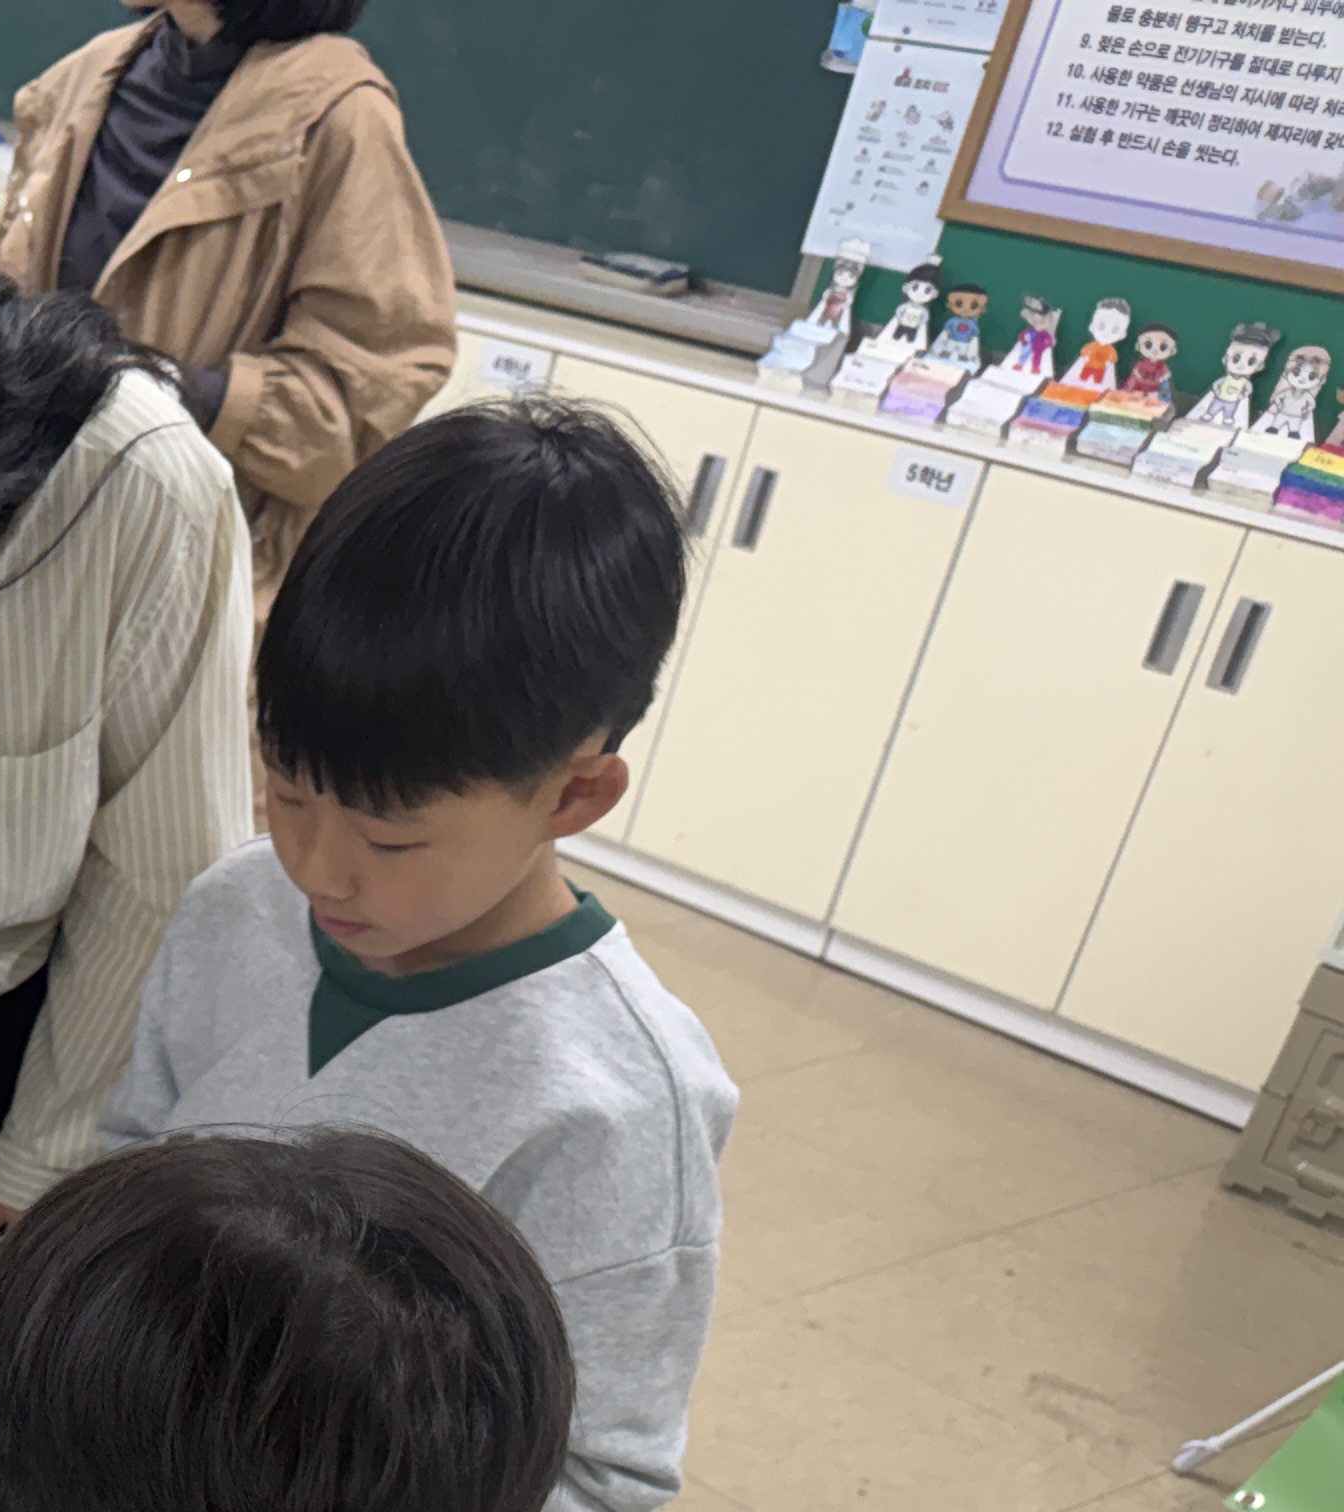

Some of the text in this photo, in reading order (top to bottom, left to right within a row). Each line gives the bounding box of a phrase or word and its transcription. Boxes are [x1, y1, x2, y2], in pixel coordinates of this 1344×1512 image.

[1107, 5, 1136, 23] 물로
[1138, 8, 1183, 31] 충분히
[1231, 20, 1278, 43] 처치를
[1278, 26, 1327, 49] 받는다.
[1079, 33, 1344, 85] 9. 젖은 손으로 전기기구를 절대로 다루지
[1067, 63, 1085, 79] 10.
[1090, 65, 1133, 87] 사용한
[1136, 71, 1179, 93] 약품은
[1180, 78, 1239, 103] 선생님의
[1240, 87, 1288, 109] 지시에
[1288, 94, 1321, 114] 따라
[1046, 121, 1241, 167] 12. 실험 후 반드시 손을 씻는다.
[1056, 92, 1075, 109] 11.
[1079, 96, 1120, 117] 사용한
[1121, 101, 1161, 123] 기구는
[1163, 107, 1206, 130] 깨끗이
[1207, 114, 1264, 138] 정리하여
[1264, 123, 1323, 148] 제자리에
[905, 462, 956, 493] 5학년
